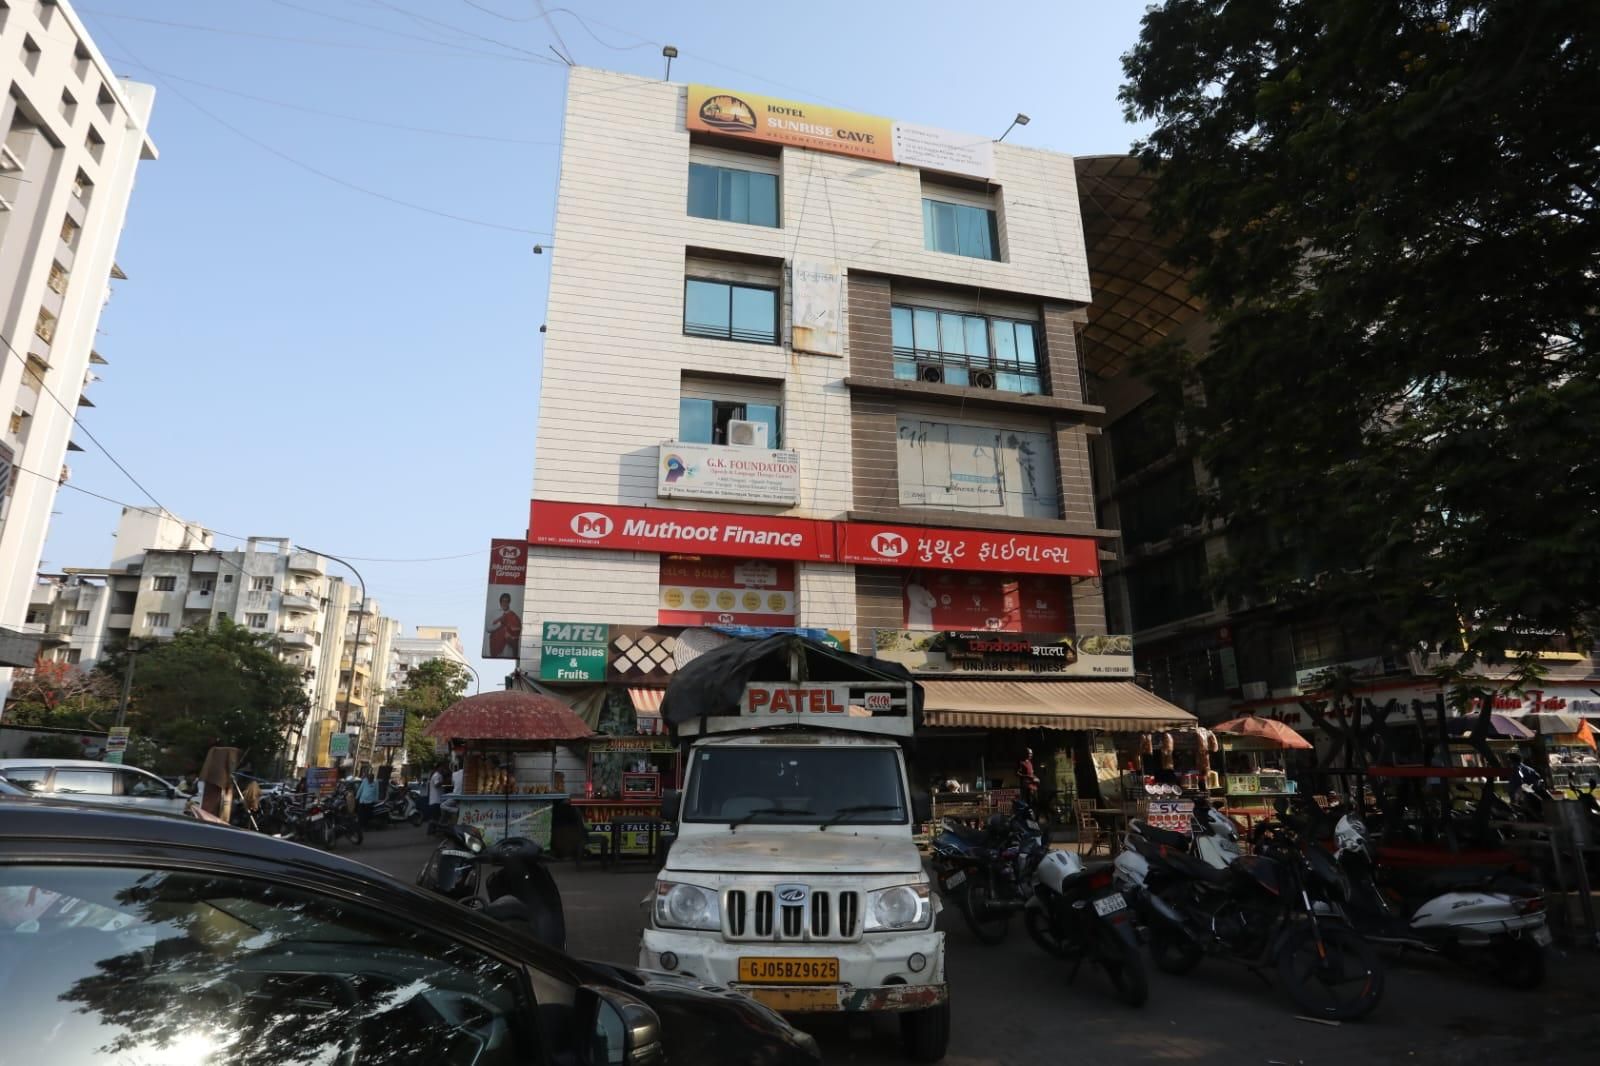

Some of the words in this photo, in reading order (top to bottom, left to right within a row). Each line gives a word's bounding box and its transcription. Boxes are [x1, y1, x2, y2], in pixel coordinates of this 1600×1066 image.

[768, 105, 805, 118] HOTEL
[768, 117, 833, 137] SUNRISE
[837, 129, 875, 145] CAVE
[707, 458, 728, 469] G.K.
[730, 460, 797, 474] FOUNDATION
[622, 519, 719, 542] Muthoot
[723, 525, 803, 547] Finance
[918, 538, 966, 564] મુથૂટ
[546, 623, 604, 641] PATEL
[545, 645, 604, 657] Vegetables
[1031, 645, 1065, 657] शाला
[569, 657, 578, 668] &
[557, 668, 589, 680] Fruits
[748, 688, 844, 713] PATEL
